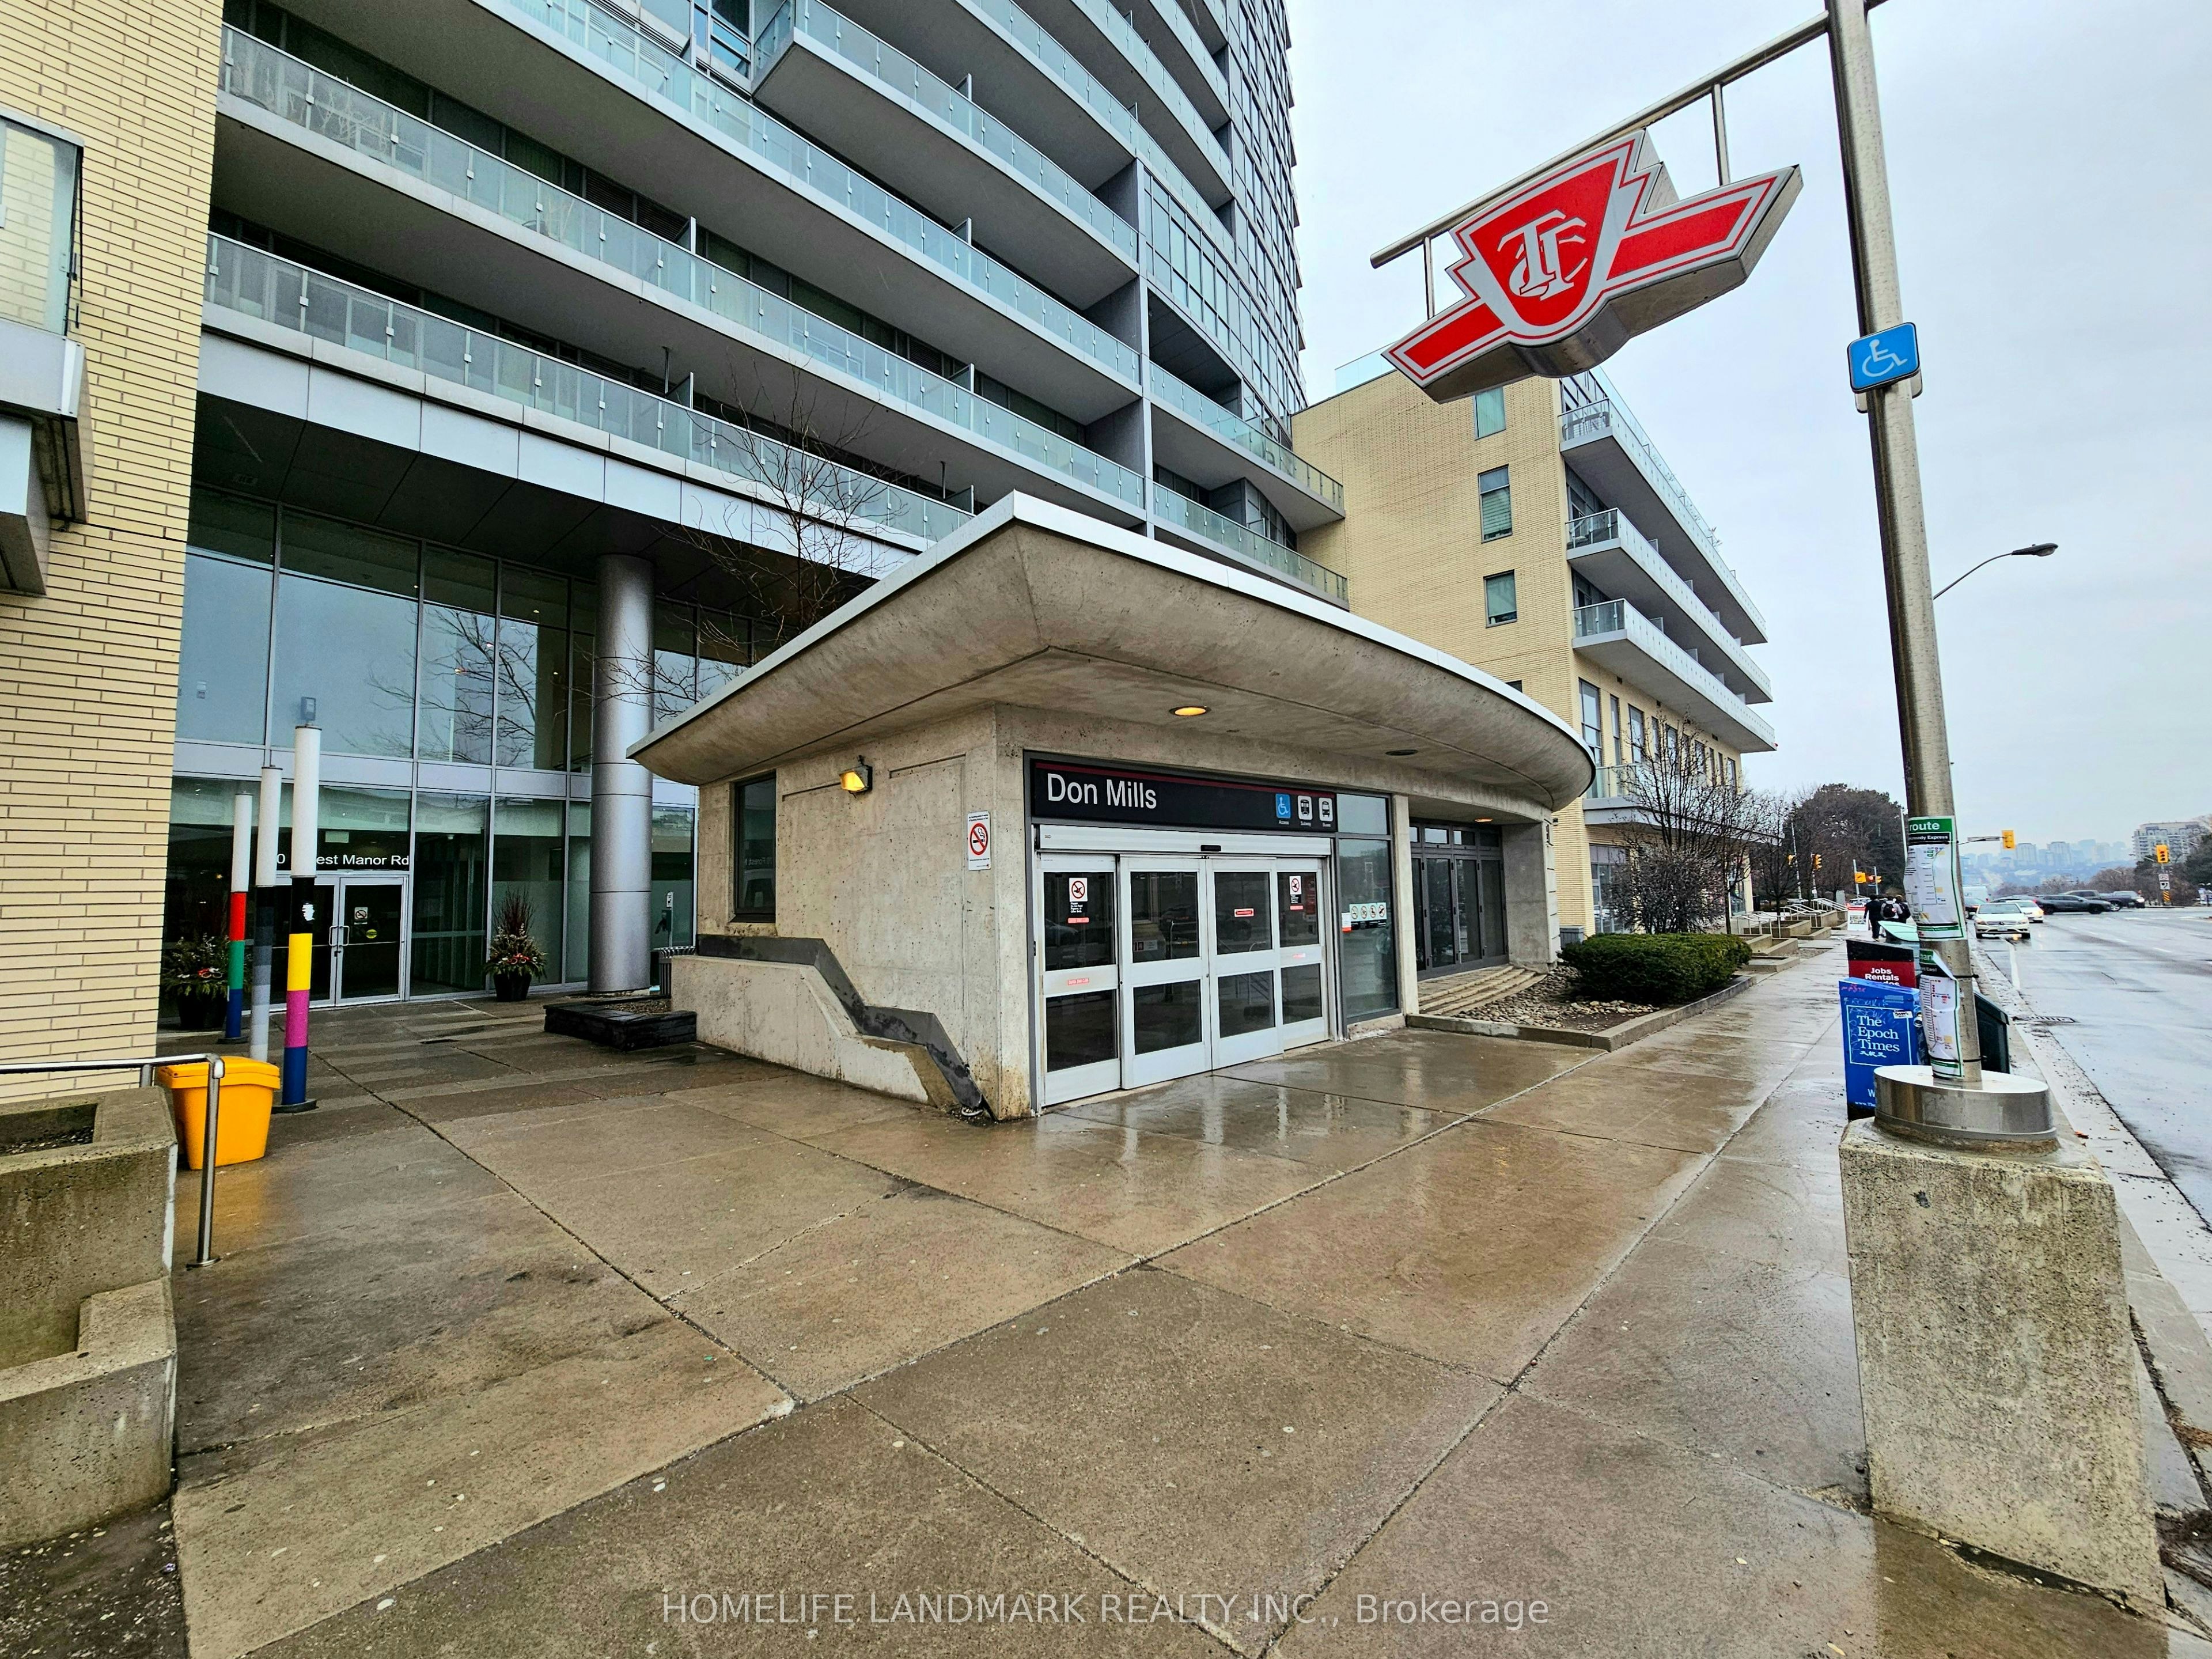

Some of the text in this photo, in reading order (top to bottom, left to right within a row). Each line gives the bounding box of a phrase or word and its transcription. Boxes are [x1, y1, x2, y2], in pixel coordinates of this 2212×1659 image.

[1497, 209, 1588, 301] TTC
[1047, 773, 1157, 809] Don Mills
[1909, 821, 1940, 831] route
[277, 854, 410, 865] 0 est Manor Rd
[1857, 1015, 1883, 1027] The
[1857, 1027, 1899, 1039] Epoch
[1858, 1039, 1900, 1052] Times
